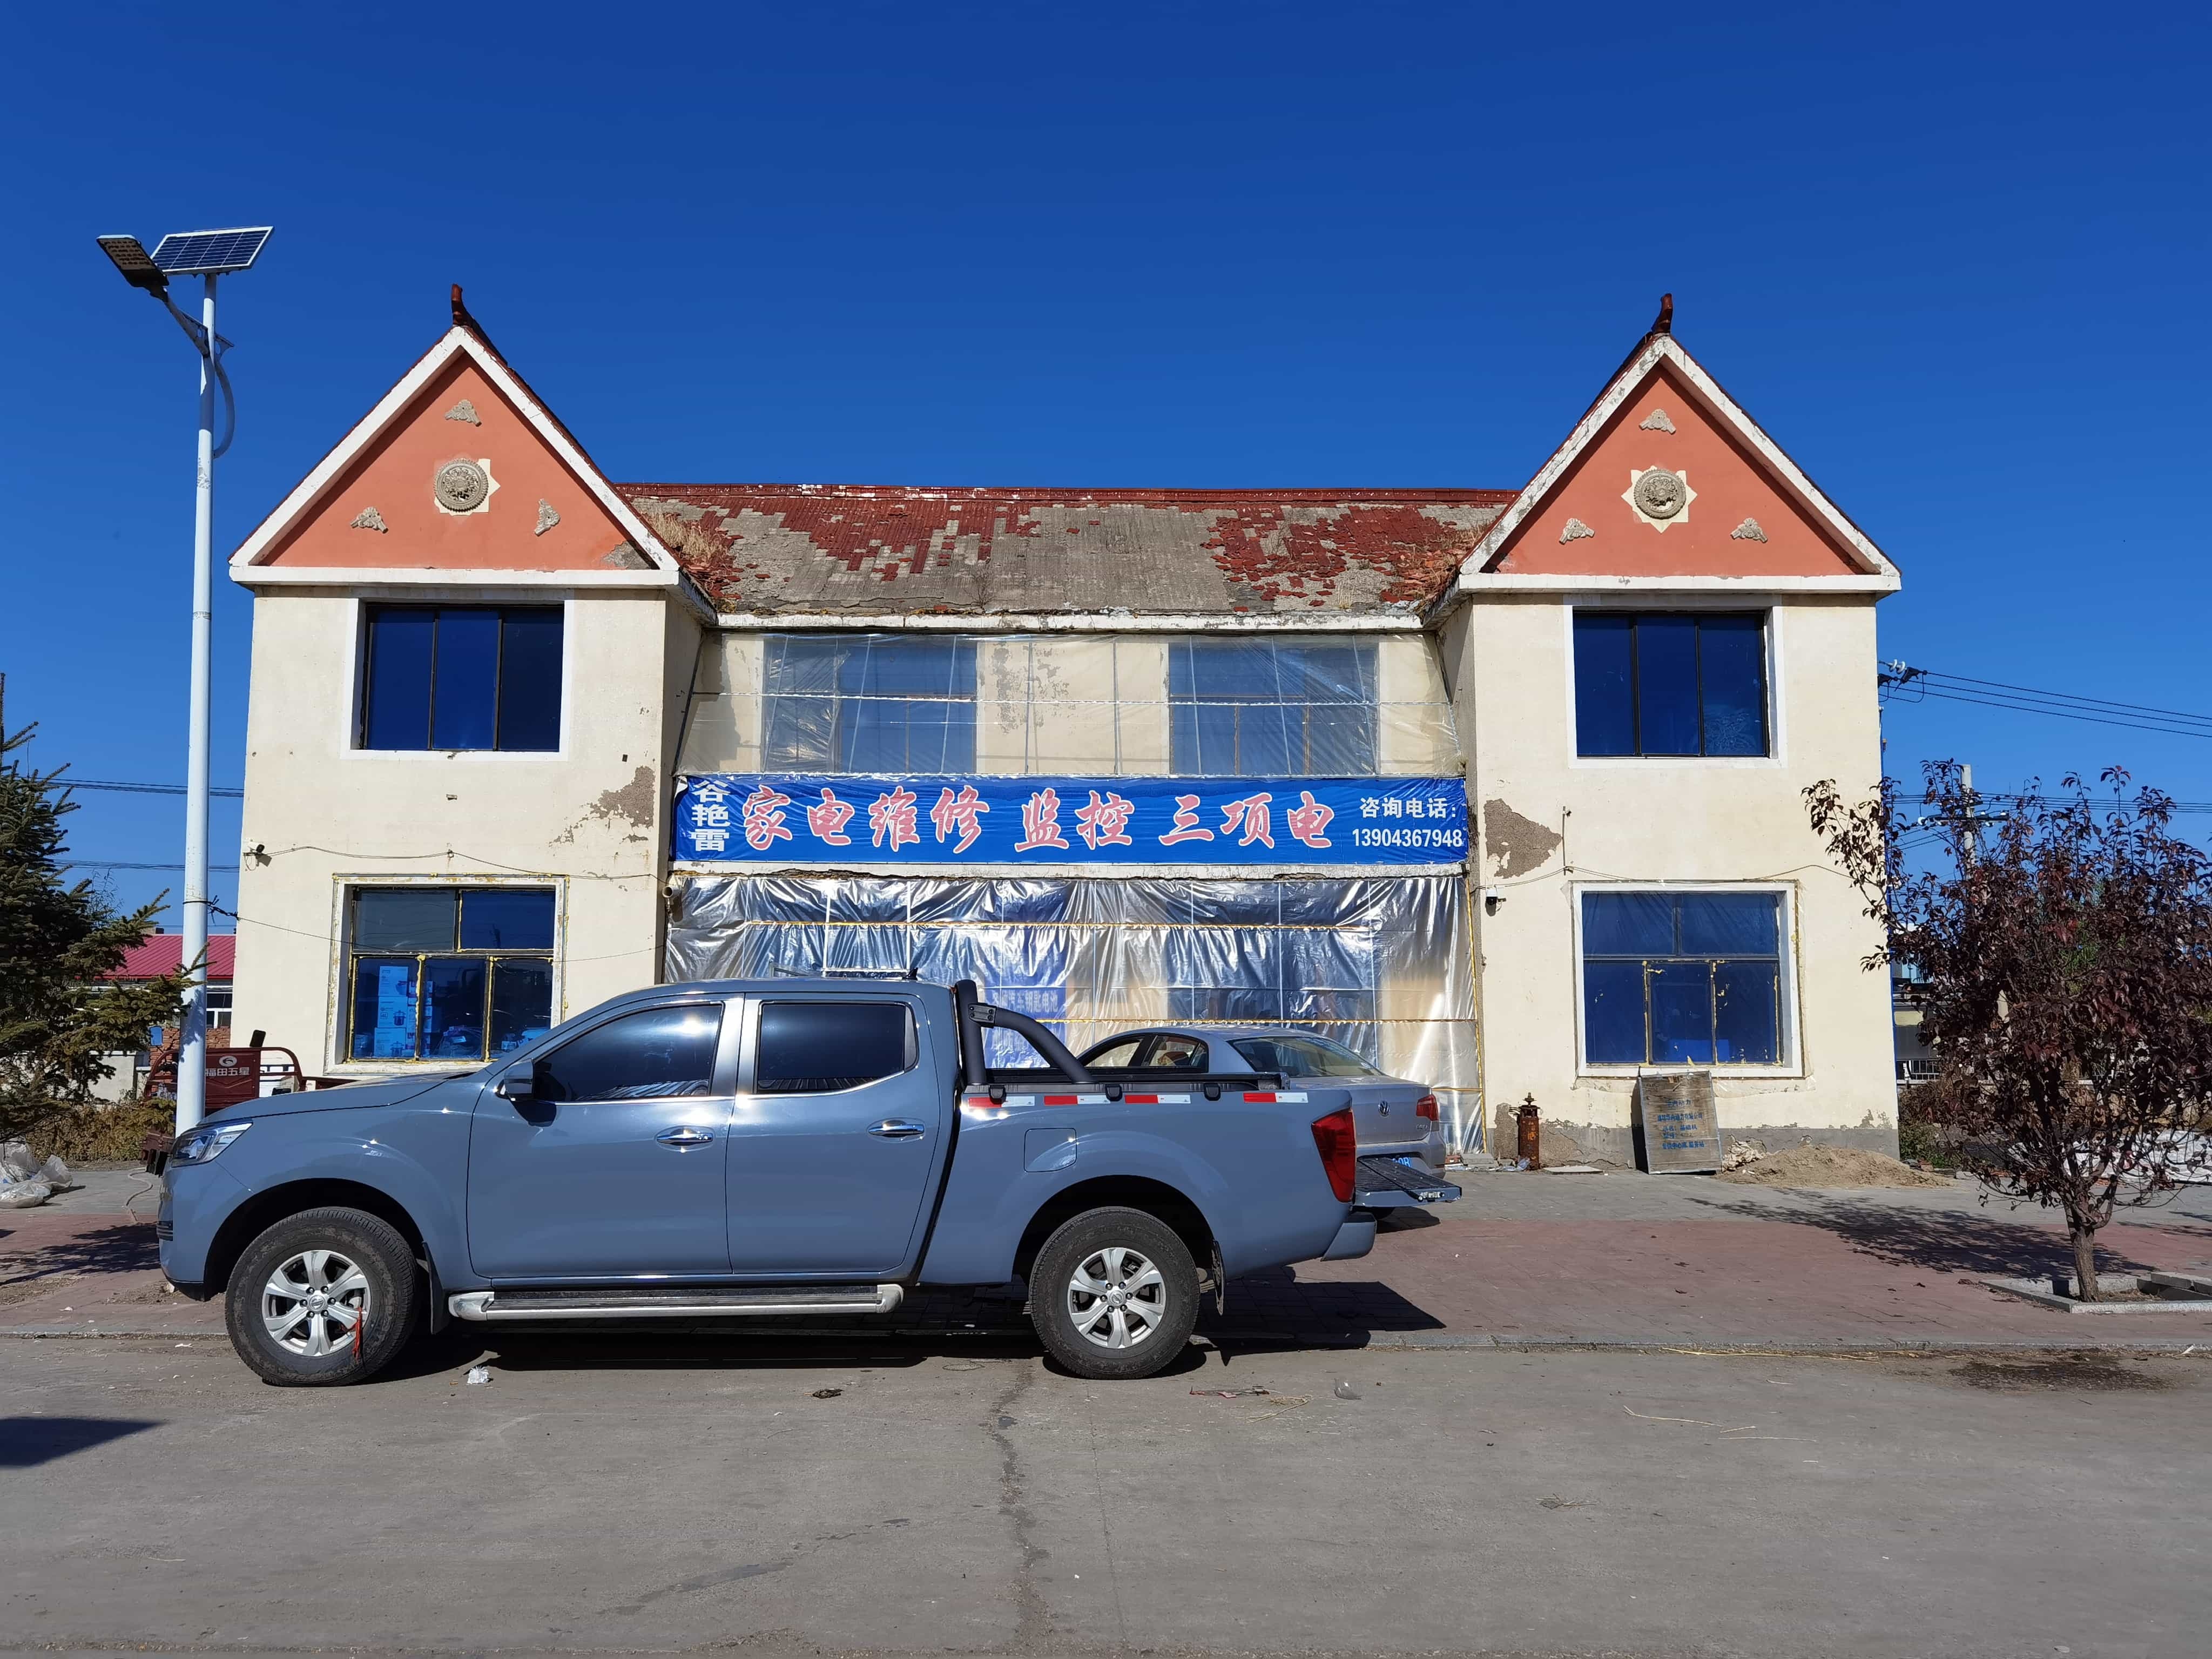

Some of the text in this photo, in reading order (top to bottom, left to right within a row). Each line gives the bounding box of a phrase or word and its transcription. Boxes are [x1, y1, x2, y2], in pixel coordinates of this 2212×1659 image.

[691, 780, 731, 852] 谷艳雷
[1359, 797, 1456, 818] 咨询电话：
[742, 784, 1335, 854] 家电维修 监控 三项电
[1352, 828, 1462, 847] 13904367948
[205, 1067, 250, 1077] 福田五星
